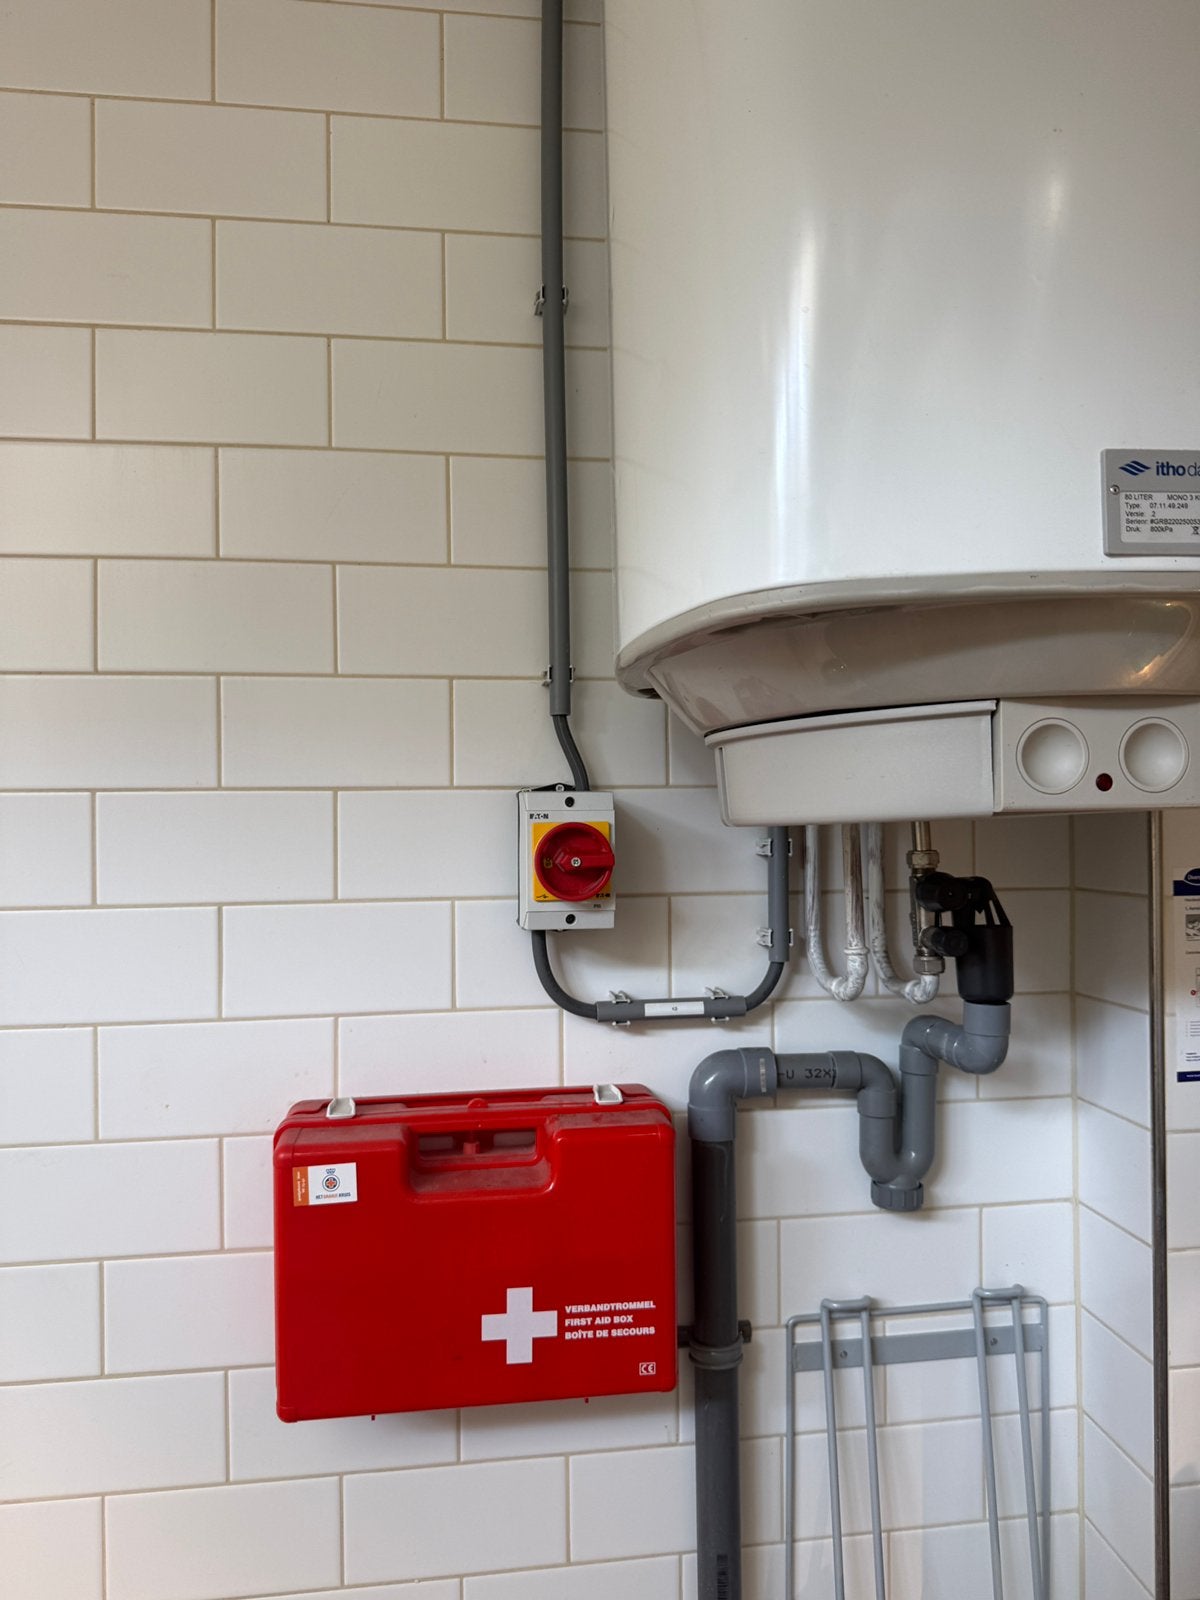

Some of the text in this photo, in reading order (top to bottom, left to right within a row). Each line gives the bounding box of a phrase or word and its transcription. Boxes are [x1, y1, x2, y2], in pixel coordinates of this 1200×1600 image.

[1156, 461, 1186, 476] itho
[565, 1301, 656, 1314] VERBANDTROMMEL
[565, 1315, 633, 1327] FIRST AID BOX
[565, 1326, 656, 1340] BOÎTE DE SECOURS
